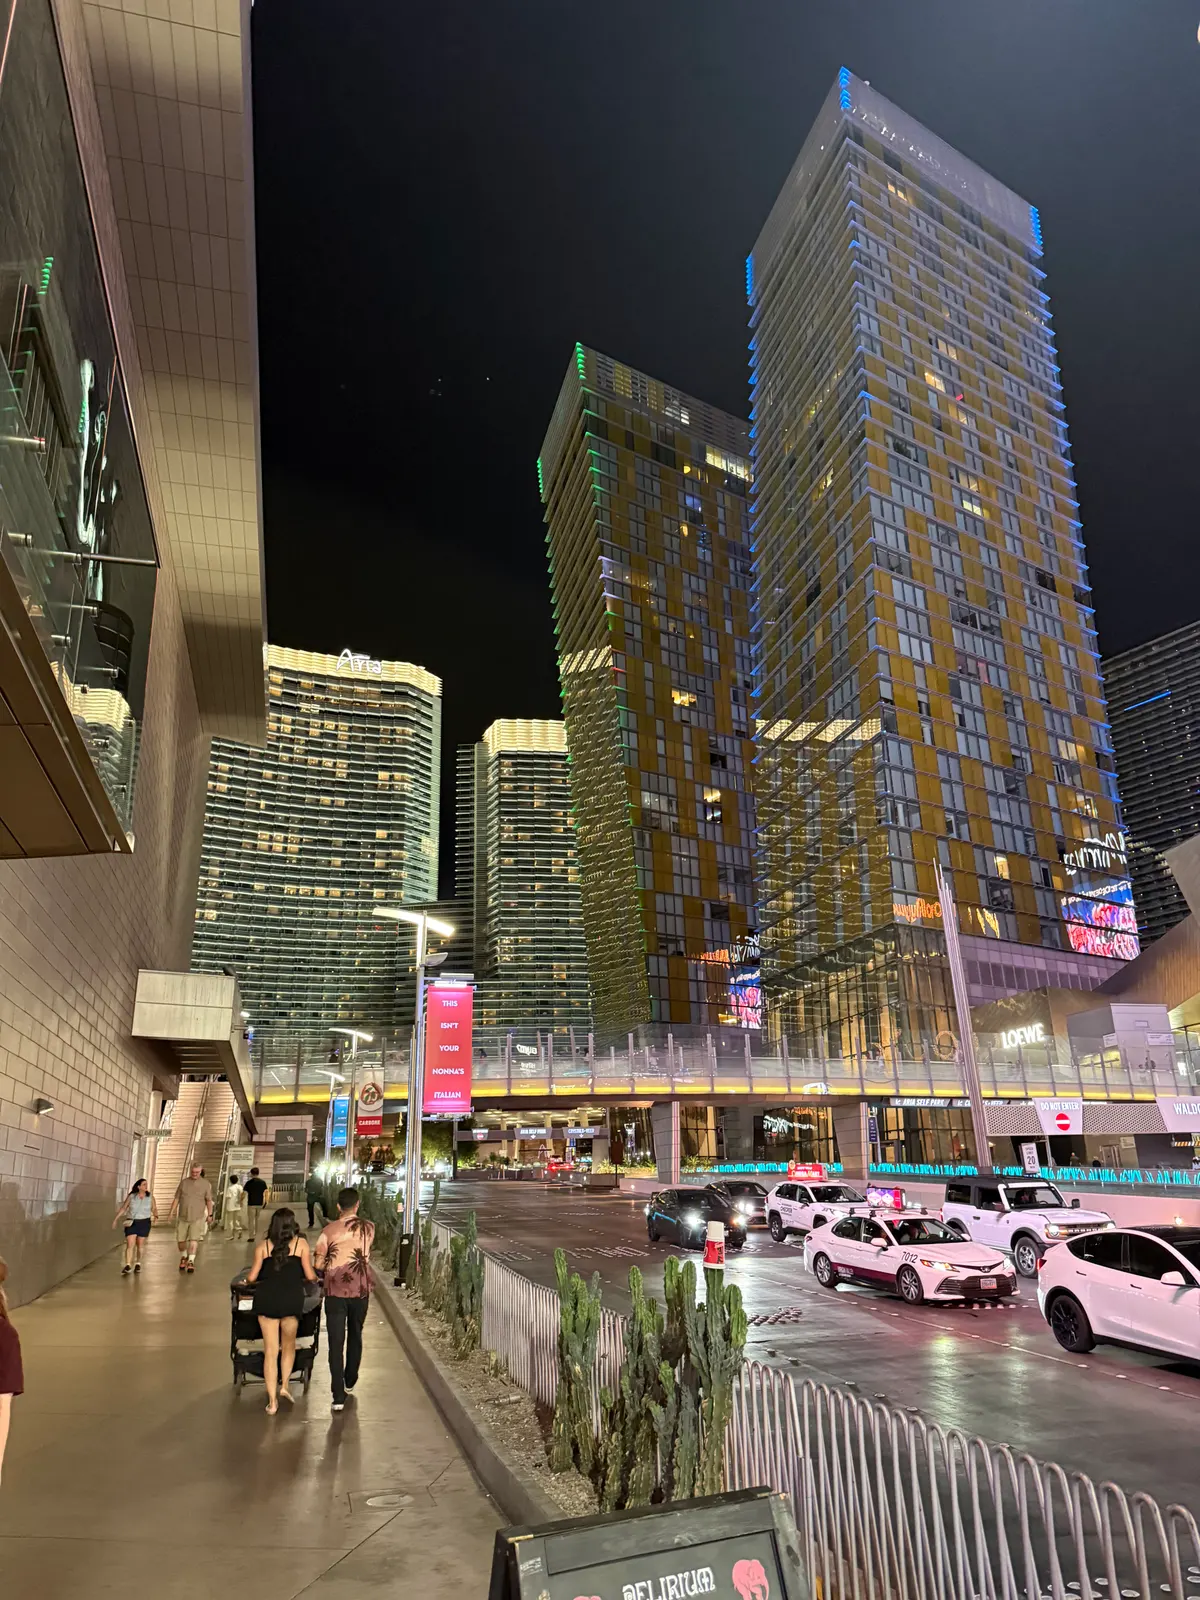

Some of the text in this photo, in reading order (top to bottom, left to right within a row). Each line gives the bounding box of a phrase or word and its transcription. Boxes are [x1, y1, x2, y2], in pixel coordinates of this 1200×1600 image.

[1001, 1022, 1045, 1049] LOEWE
[433, 1091, 461, 1099] ITALIAN
[1040, 1102, 1050, 1111] DO
[1050, 1102, 1062, 1111] NOT
[1061, 1101, 1080, 1111] ENTER
[1027, 1155, 1036, 1165] 20
[901, 1251, 919, 1264] 7012
[622, 1566, 716, 1600] DELIRIUM
